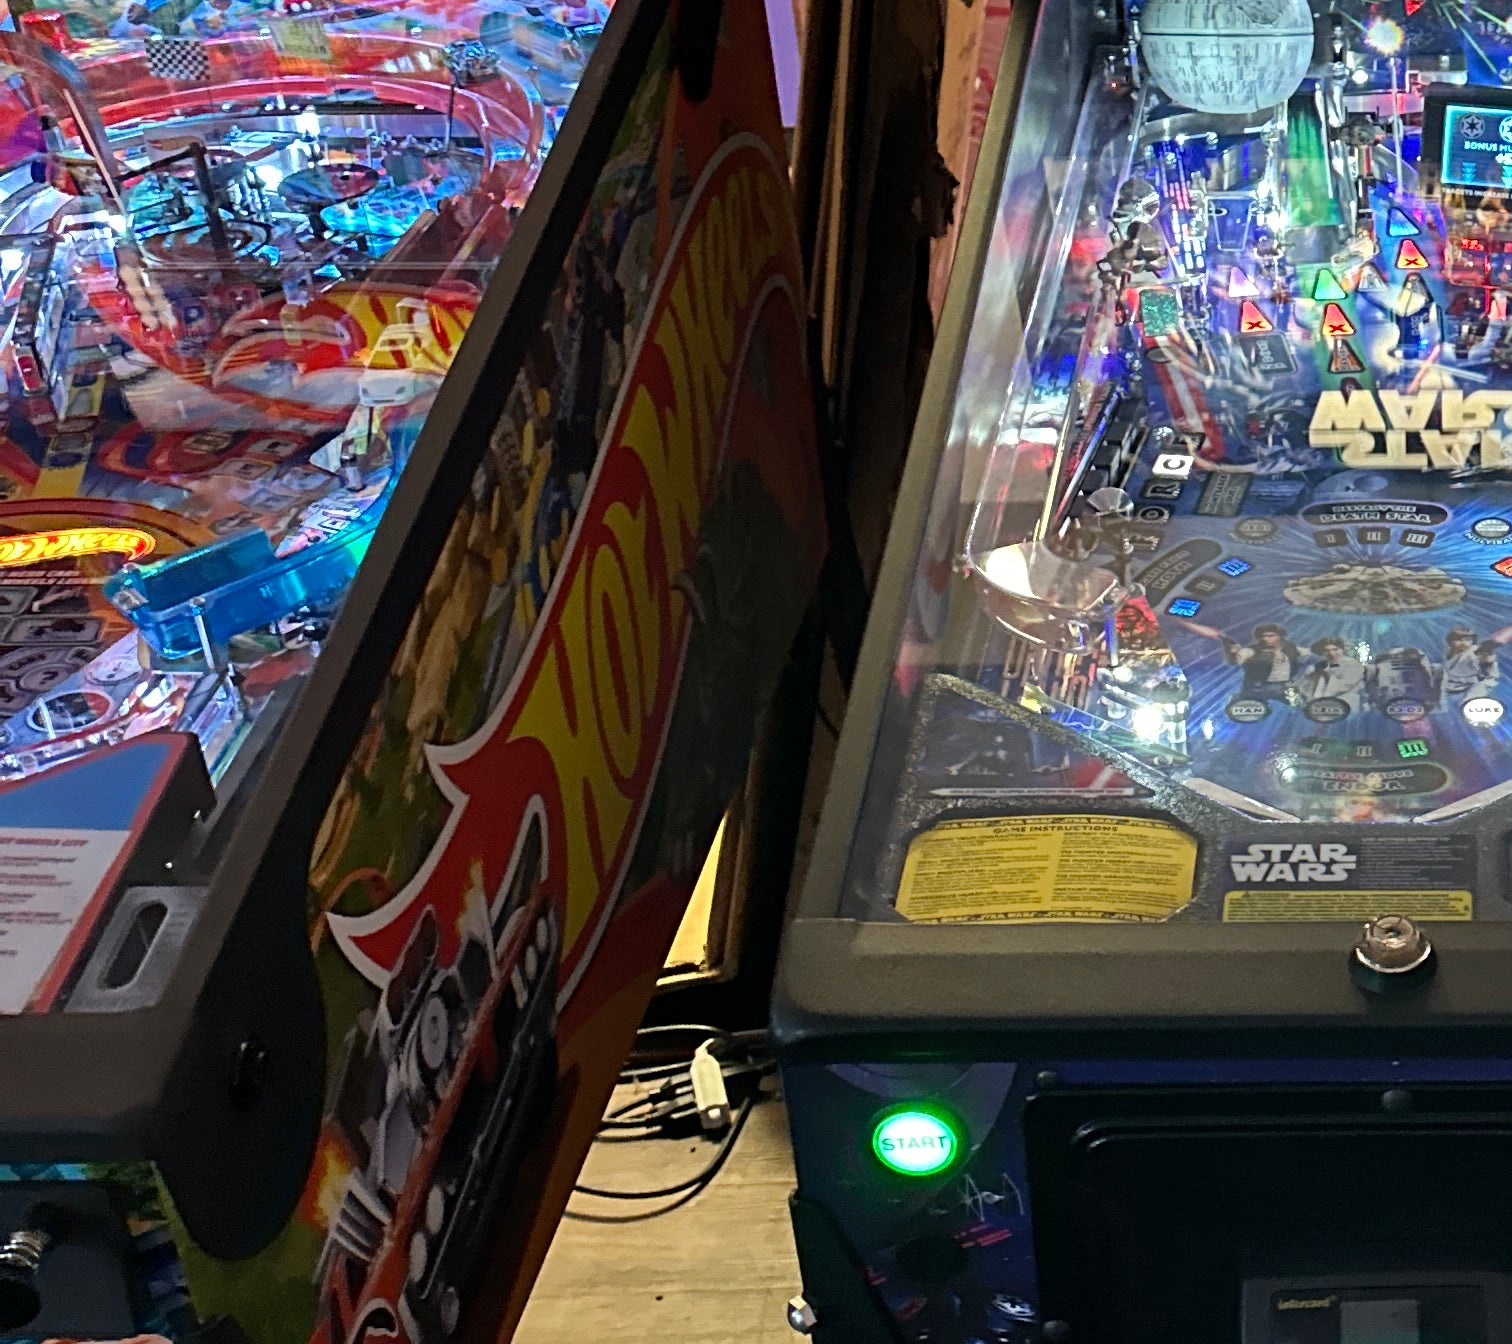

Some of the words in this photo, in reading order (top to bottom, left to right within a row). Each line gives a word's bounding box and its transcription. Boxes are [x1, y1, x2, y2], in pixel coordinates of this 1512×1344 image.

[1464, 141, 1498, 152] BONUS
[1319, 512, 1381, 523] DEATH
[1385, 513, 1432, 524] STAR
[1232, 705, 1265, 715] HAN
[1311, 705, 1344, 715] LEIA
[1468, 706, 1500, 714] LUKE
[1029, 825, 1119, 834] INSTRUCTIONS
[1231, 843, 1356, 863] STAR
[1231, 862, 1356, 882] WARS
[882, 1135, 948, 1151] START
